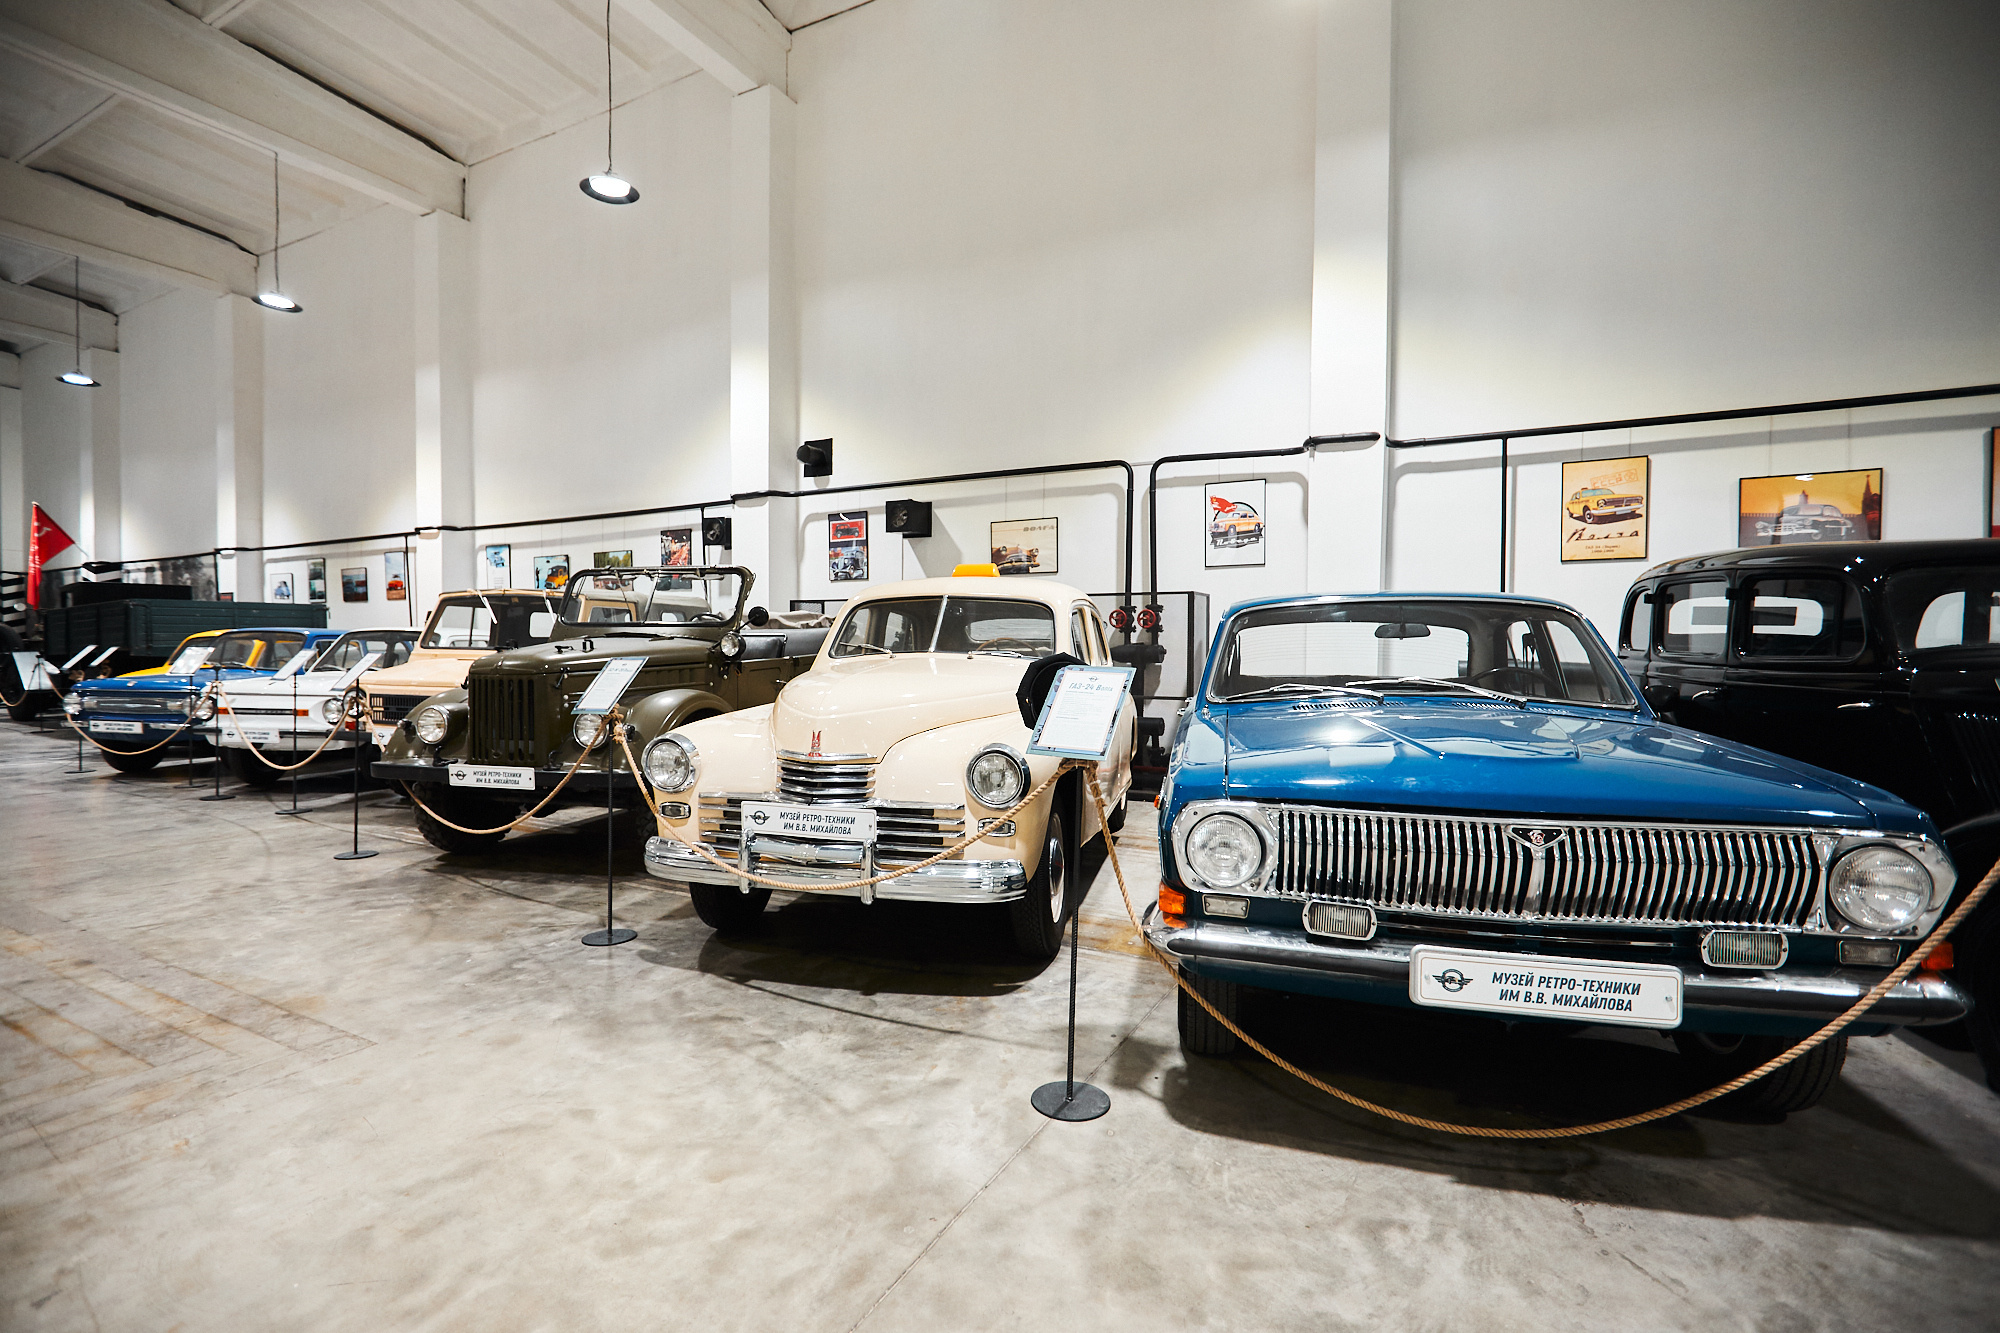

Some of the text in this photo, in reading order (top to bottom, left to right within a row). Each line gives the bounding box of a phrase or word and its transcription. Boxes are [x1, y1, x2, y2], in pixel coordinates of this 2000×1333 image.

[1069, 682, 1094, 690] ГАЗ-24
[780, 811, 855, 824] МУЗЕЙ РЕТРО-ТЕХНИКИ
[784, 822, 851, 834] ИМ В.В. МИХАЙЛОВА
[1491, 971, 1641, 996] МУЗЕЙ РЕТРО-ТЕХНИКИ
[1499, 989, 1633, 1012] ИМ В.В. МИХАЙЛОВА
